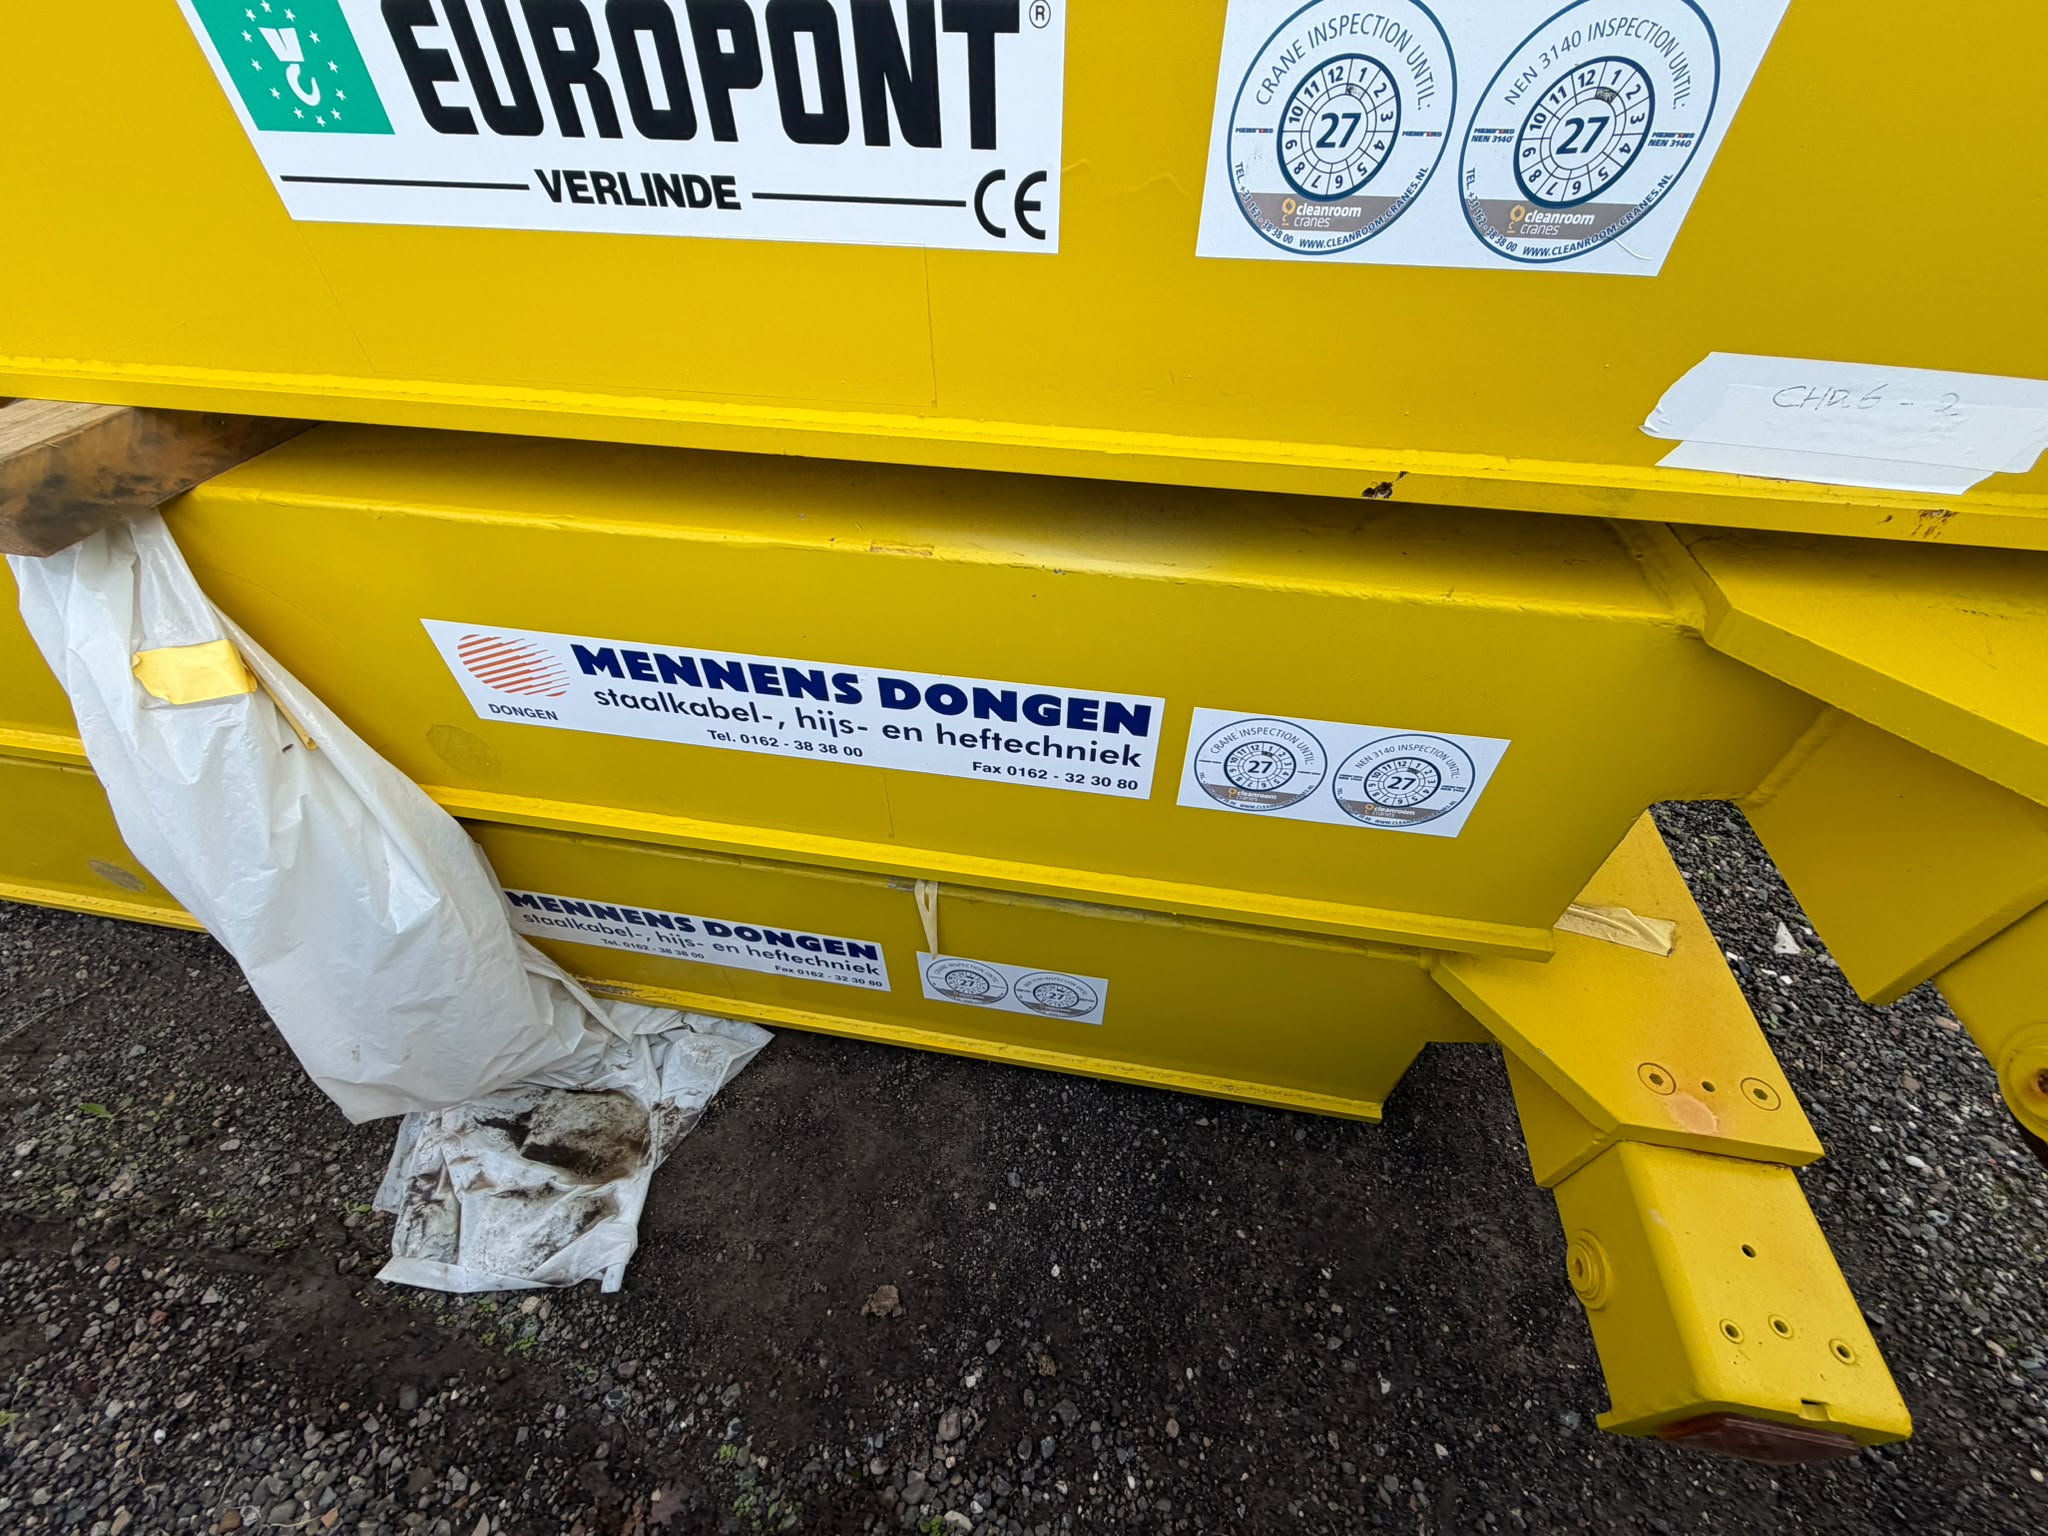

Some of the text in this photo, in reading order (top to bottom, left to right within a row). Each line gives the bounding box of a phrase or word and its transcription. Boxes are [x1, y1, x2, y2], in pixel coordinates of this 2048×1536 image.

[1256, 13, 1435, 110] CRANE INSPECTION UNTIL:
[1504, 17, 1691, 110] NEN 3140 INSPECTION UNTIL:
[381, 0, 1020, 150] EUROPONT
[1328, 66, 1344, 83] 12
[1359, 67, 1367, 82] 1
[1578, 69, 1596, 88] 12
[1611, 69, 1622, 85] 1
[1304, 80, 1320, 98] 11
[1374, 82, 1387, 98] 2
[1550, 86, 1567, 104] 11
[1626, 84, 1641, 100] 2
[1289, 106, 1303, 123] 10
[1381, 111, 1393, 122] 3
[1530, 112, 1546, 131] 10
[1630, 112, 1645, 124] 3
[1316, 113, 1361, 148] 27
[1556, 116, 1610, 155] 27
[1285, 140, 1297, 150] 9
[1374, 140, 1385, 151] 4
[1522, 148, 1536, 158] 9
[1619, 143, 1631, 154] 4
[1294, 162, 1305, 174] 8
[1357, 162, 1367, 176] 5
[1529, 169, 1542, 182] 8
[1598, 167, 1609, 181] 5
[1312, 175, 1322, 188] 7
[1335, 175, 1343, 188] 6
[1546, 182, 1558, 195] 7
[1572, 181, 1581, 195] 6
[534, 169, 741, 211] VERLINDE
[974, 170, 1048, 240] CE
[1235, 162, 1244, 184] TEL.
[1248, 202, 1260, 219] 162
[1283, 234, 1294, 244] 00
[1296, 203, 1361, 217] cleanroom
[1466, 168, 1475, 190] TEL.
[1474, 208, 1487, 228] 162
[1506, 241, 1517, 252] 00
[1294, 216, 1330, 228] cranes
[1525, 210, 1595, 224] cleanroom
[1520, 223, 1560, 235] cranes
[1934, 393, 1960, 416] 2
[570, 644, 1151, 738] MENNENS DONGEN
[489, 703, 558, 720] DONGEN
[707, 729, 736, 743] Tel.
[740, 733, 778, 748] 0162
[793, 739, 813, 752] 38
[818, 742, 838, 755] 38
[843, 746, 863, 758] 00
[795, 706, 868, 738] hijs-
[882, 724, 923, 742] en
[936, 723, 1142, 768] heftechniek
[1210, 732, 1238, 754] CRANE
[1239, 727, 1300, 744] INSPECTION
[1355, 756, 1373, 768] NEN
[1372, 746, 1395, 758] 3140
[1398, 744, 1449, 760] INSPECTION
[1247, 760, 1273, 774] 27
[972, 761, 1002, 775] Fax
[1007, 765, 1048, 780] 0162
[1064, 772, 1086, 784] 32
[1090, 775, 1112, 788] 30
[1117, 778, 1138, 791] 80
[1387, 776, 1416, 790] 27
[1237, 791, 1277, 800] cleanroom
[1374, 807, 1415, 816] cleanroom
[505, 891, 878, 960] MENNENS DONGEN
[601, 938, 622, 947] Tel.
[623, 942, 648, 950] 0162
[657, 931, 704, 948] hijs-
[713, 942, 740, 954] en
[746, 944, 880, 976] heftechniek
[775, 965, 794, 974] Fax
[798, 968, 824, 978] 0162
[835, 974, 849, 982] 32
[1049, 992, 1064, 1000] 27
